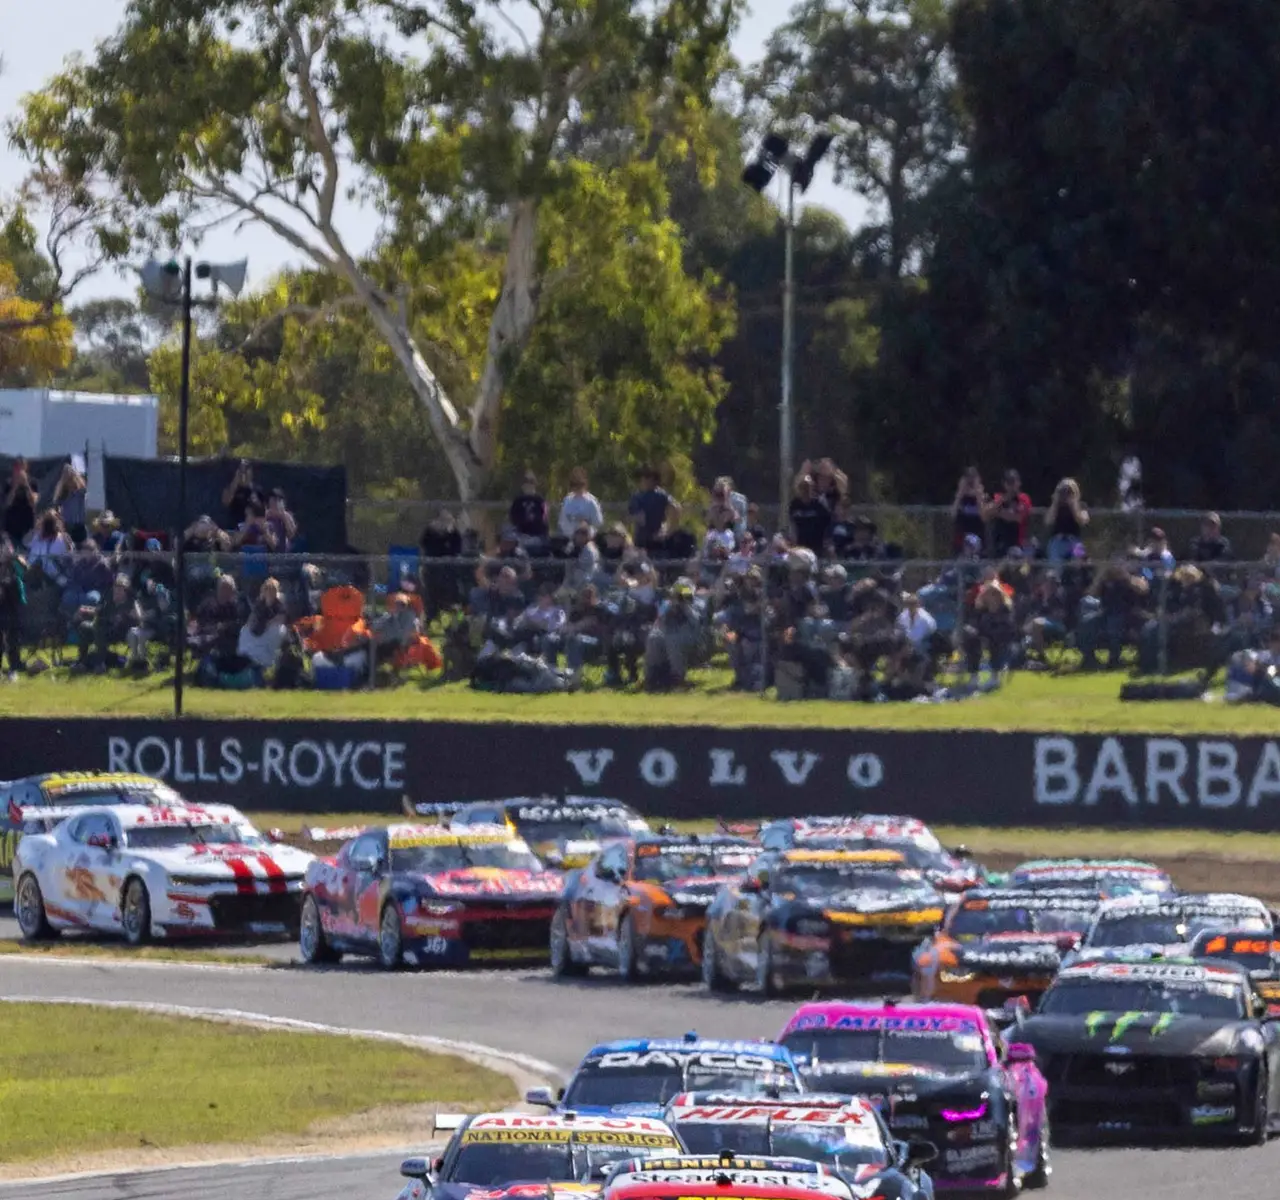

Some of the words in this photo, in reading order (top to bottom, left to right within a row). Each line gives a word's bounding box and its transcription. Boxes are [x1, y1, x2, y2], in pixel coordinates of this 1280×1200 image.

[108, 736, 406, 789] ROLLS-ROYCE
[566, 747, 884, 789] VOLVO
[599, 1050, 776, 1070] DAYCO
[468, 1131, 566, 1142] NATIONAL
